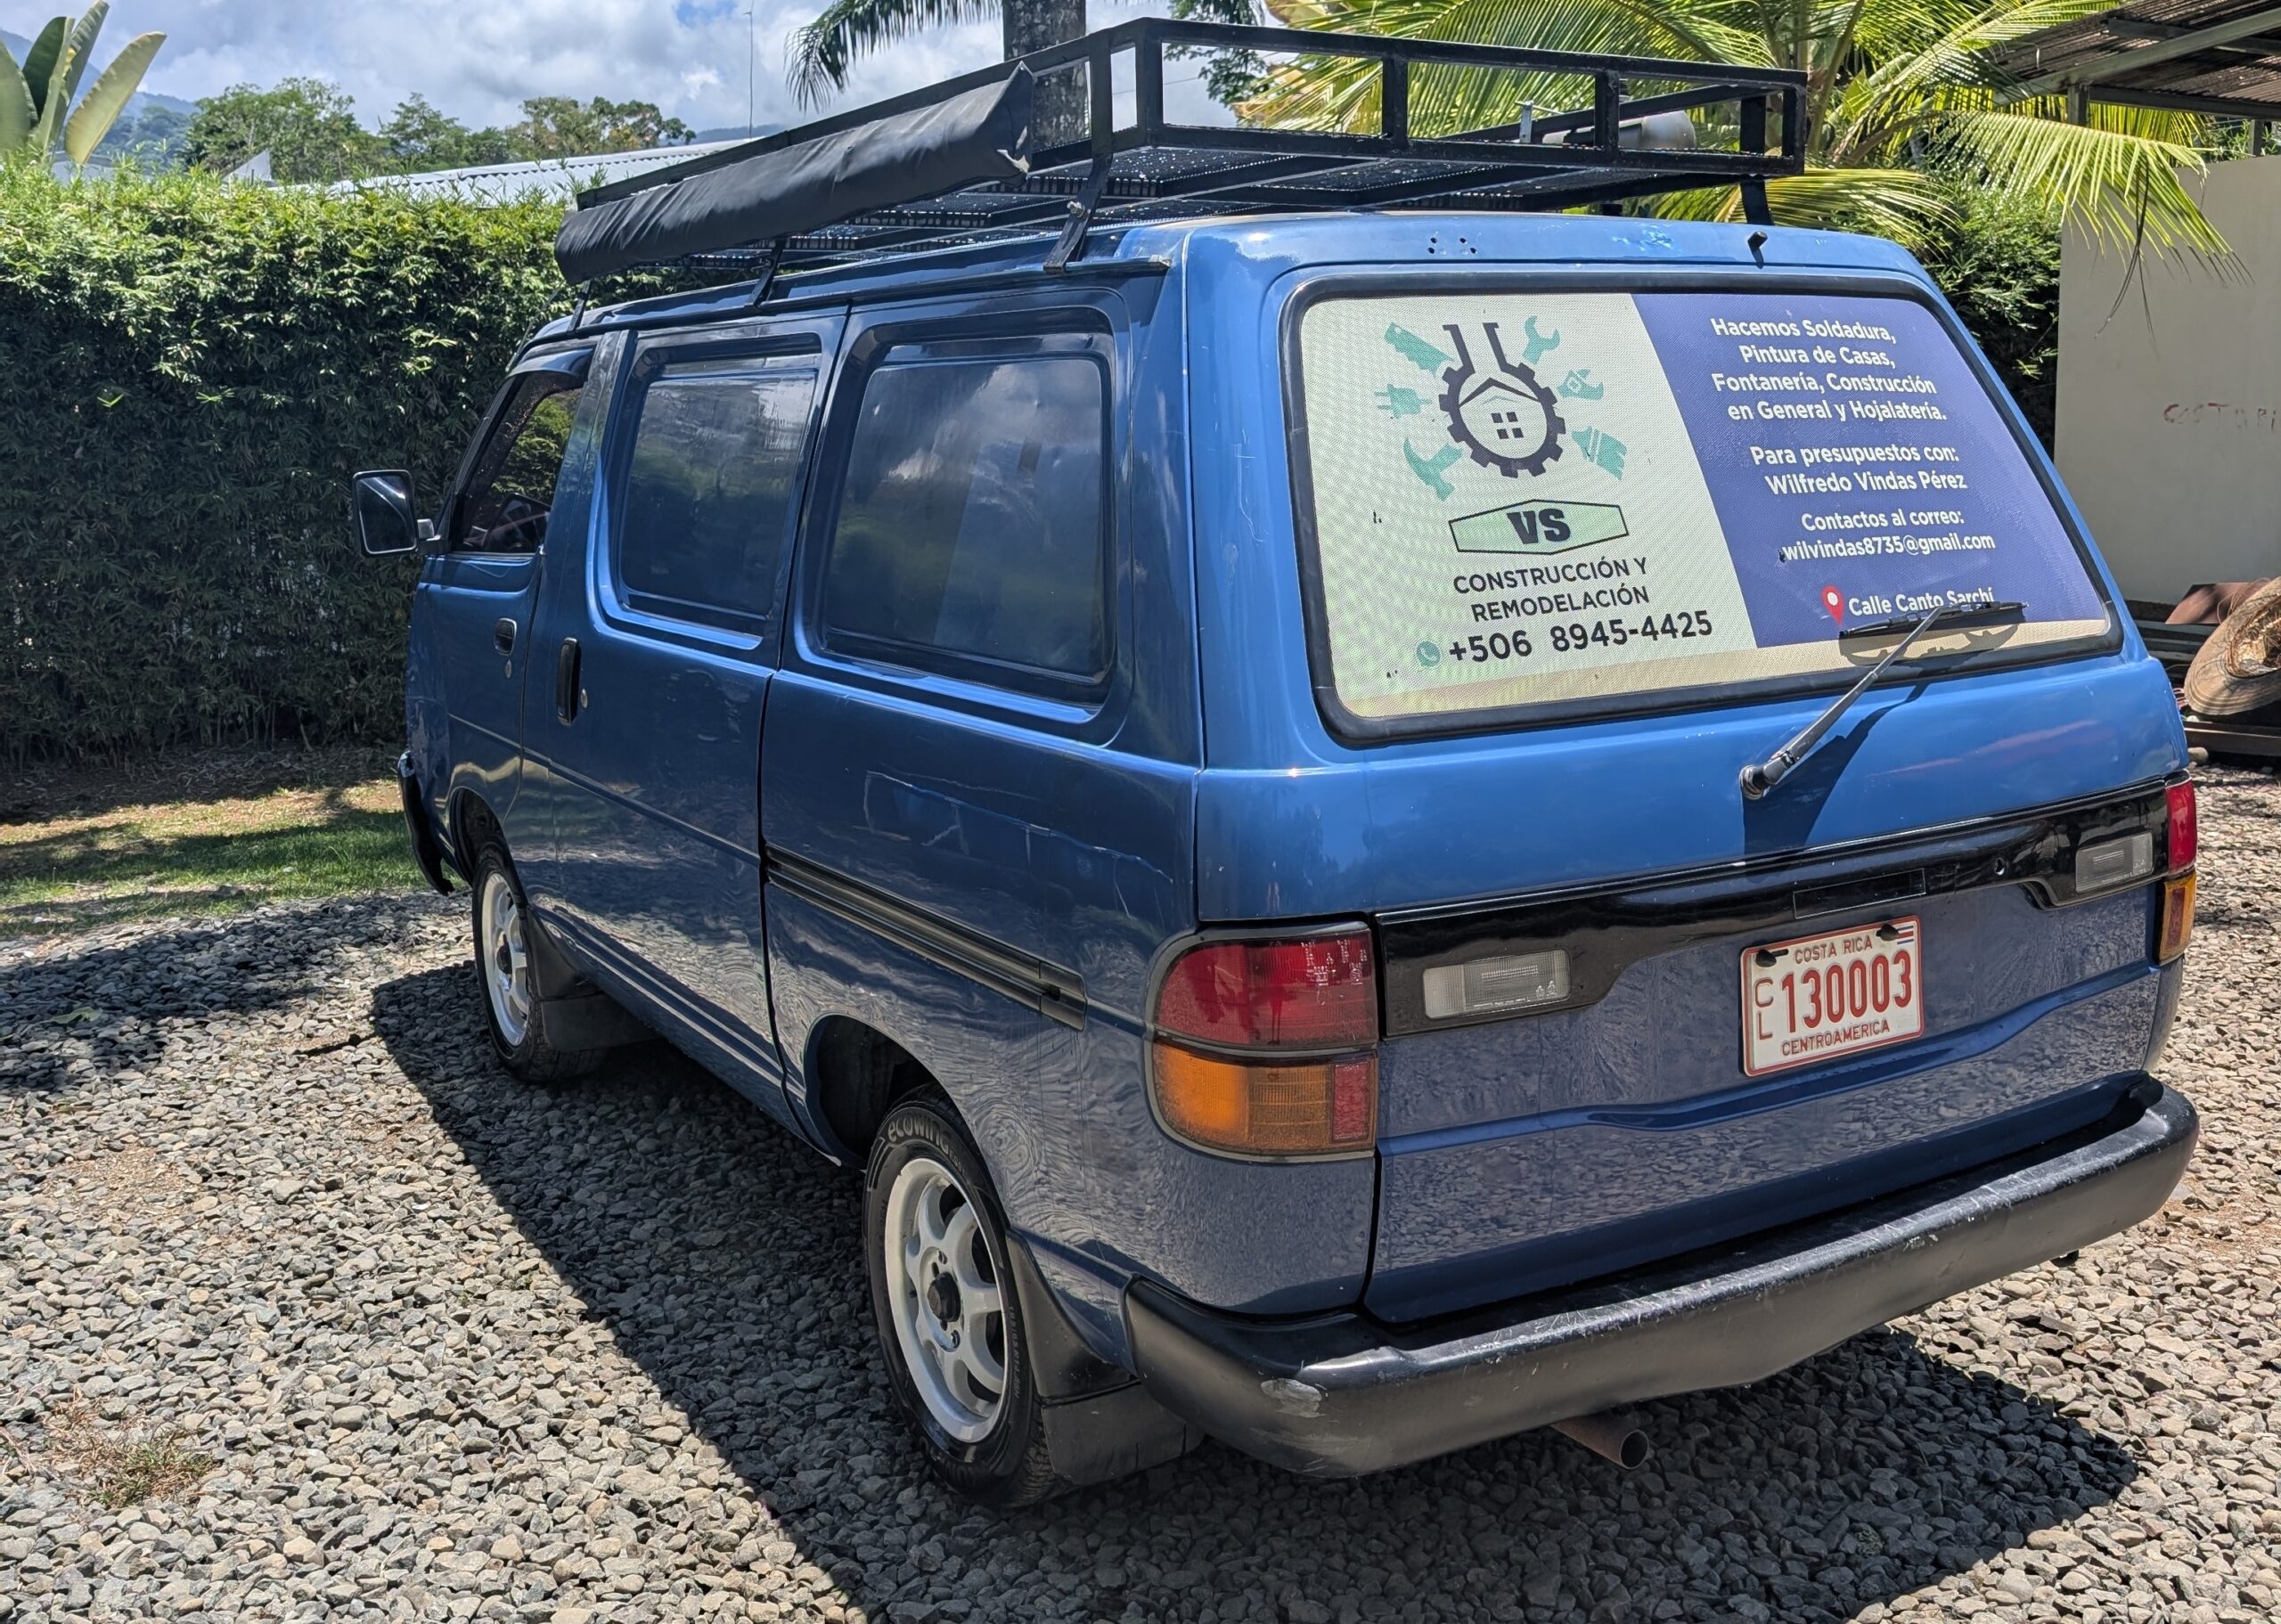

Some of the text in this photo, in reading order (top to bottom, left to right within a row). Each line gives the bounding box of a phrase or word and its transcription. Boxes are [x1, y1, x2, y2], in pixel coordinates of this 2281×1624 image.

[1710, 318, 1897, 344] Hacemos Soldadura,
[1738, 345, 1896, 369] Pintura de Casas,
[1711, 371, 1937, 394] Fontanería, Construcción
[1728, 400, 1948, 422] en General y Hojalatería.
[1750, 444, 1959, 467] Para presupuestos con:
[1764, 469, 1967, 495] Wilfredo Vindas Pérez
[1506, 508, 1572, 545] VS
[1801, 509, 1965, 532] Contactos al correo:
[1782, 533, 1996, 561] wilvindas8735@gmail.com
[1453, 556, 1647, 594] CONSTRUCCIÓN Y
[1471, 583, 1650, 623] REMODELACIÓN
[1848, 587, 1995, 616] Calle Canto Sarchí
[1449, 609, 1713, 663] +506 8945-4425
[1795, 934, 1873, 965] COSTA RICA
[1781, 949, 1912, 1033] 130003
[1782, 1019, 1891, 1057] CENTROAMERICA
